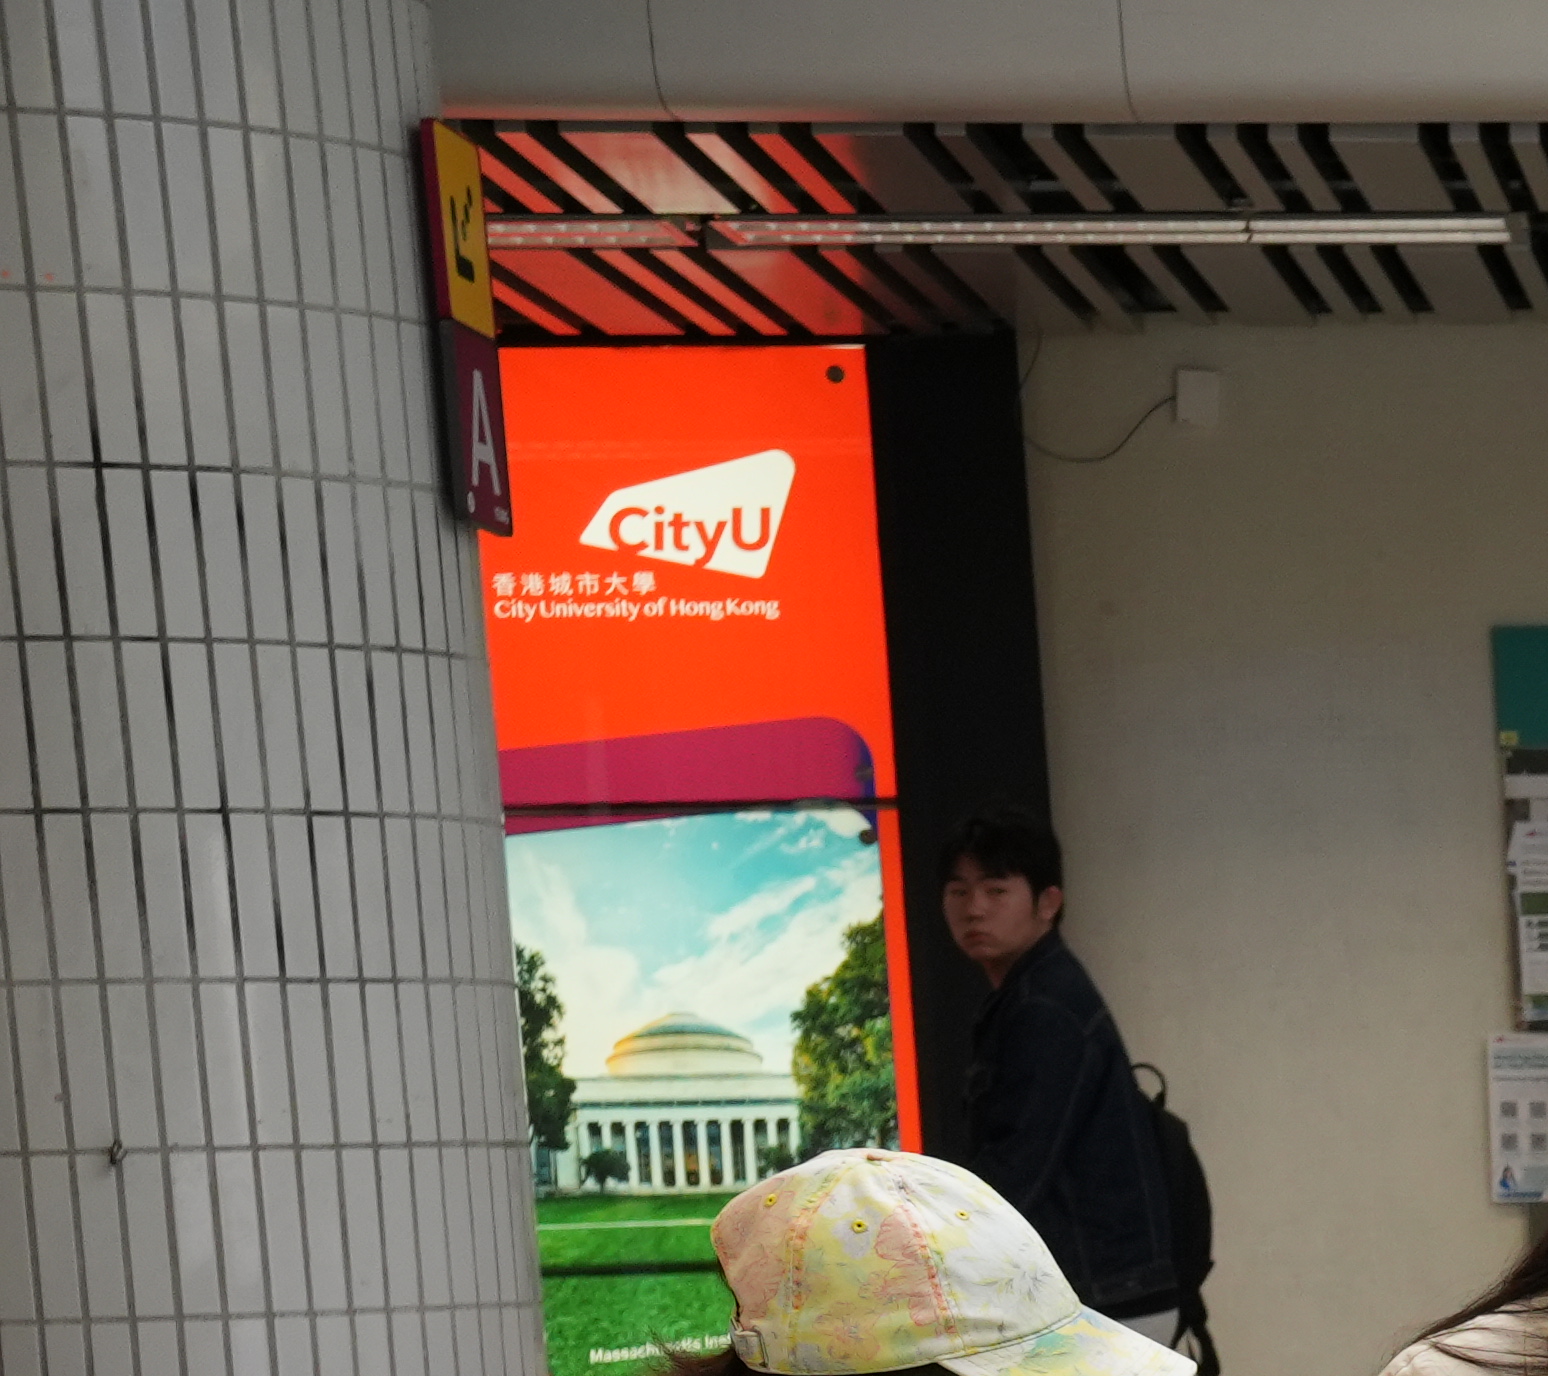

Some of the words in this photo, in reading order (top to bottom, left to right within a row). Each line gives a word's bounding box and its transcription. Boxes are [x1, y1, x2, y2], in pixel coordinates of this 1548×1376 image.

[472, 369, 502, 497] A
[608, 505, 771, 569] CityU
[491, 570, 658, 597] 香港城市大學
[493, 598, 538, 623] City
[540, 597, 641, 622] University
[643, 596, 669, 618] of
[670, 598, 725, 621] Hong
[726, 598, 781, 621] Kong
